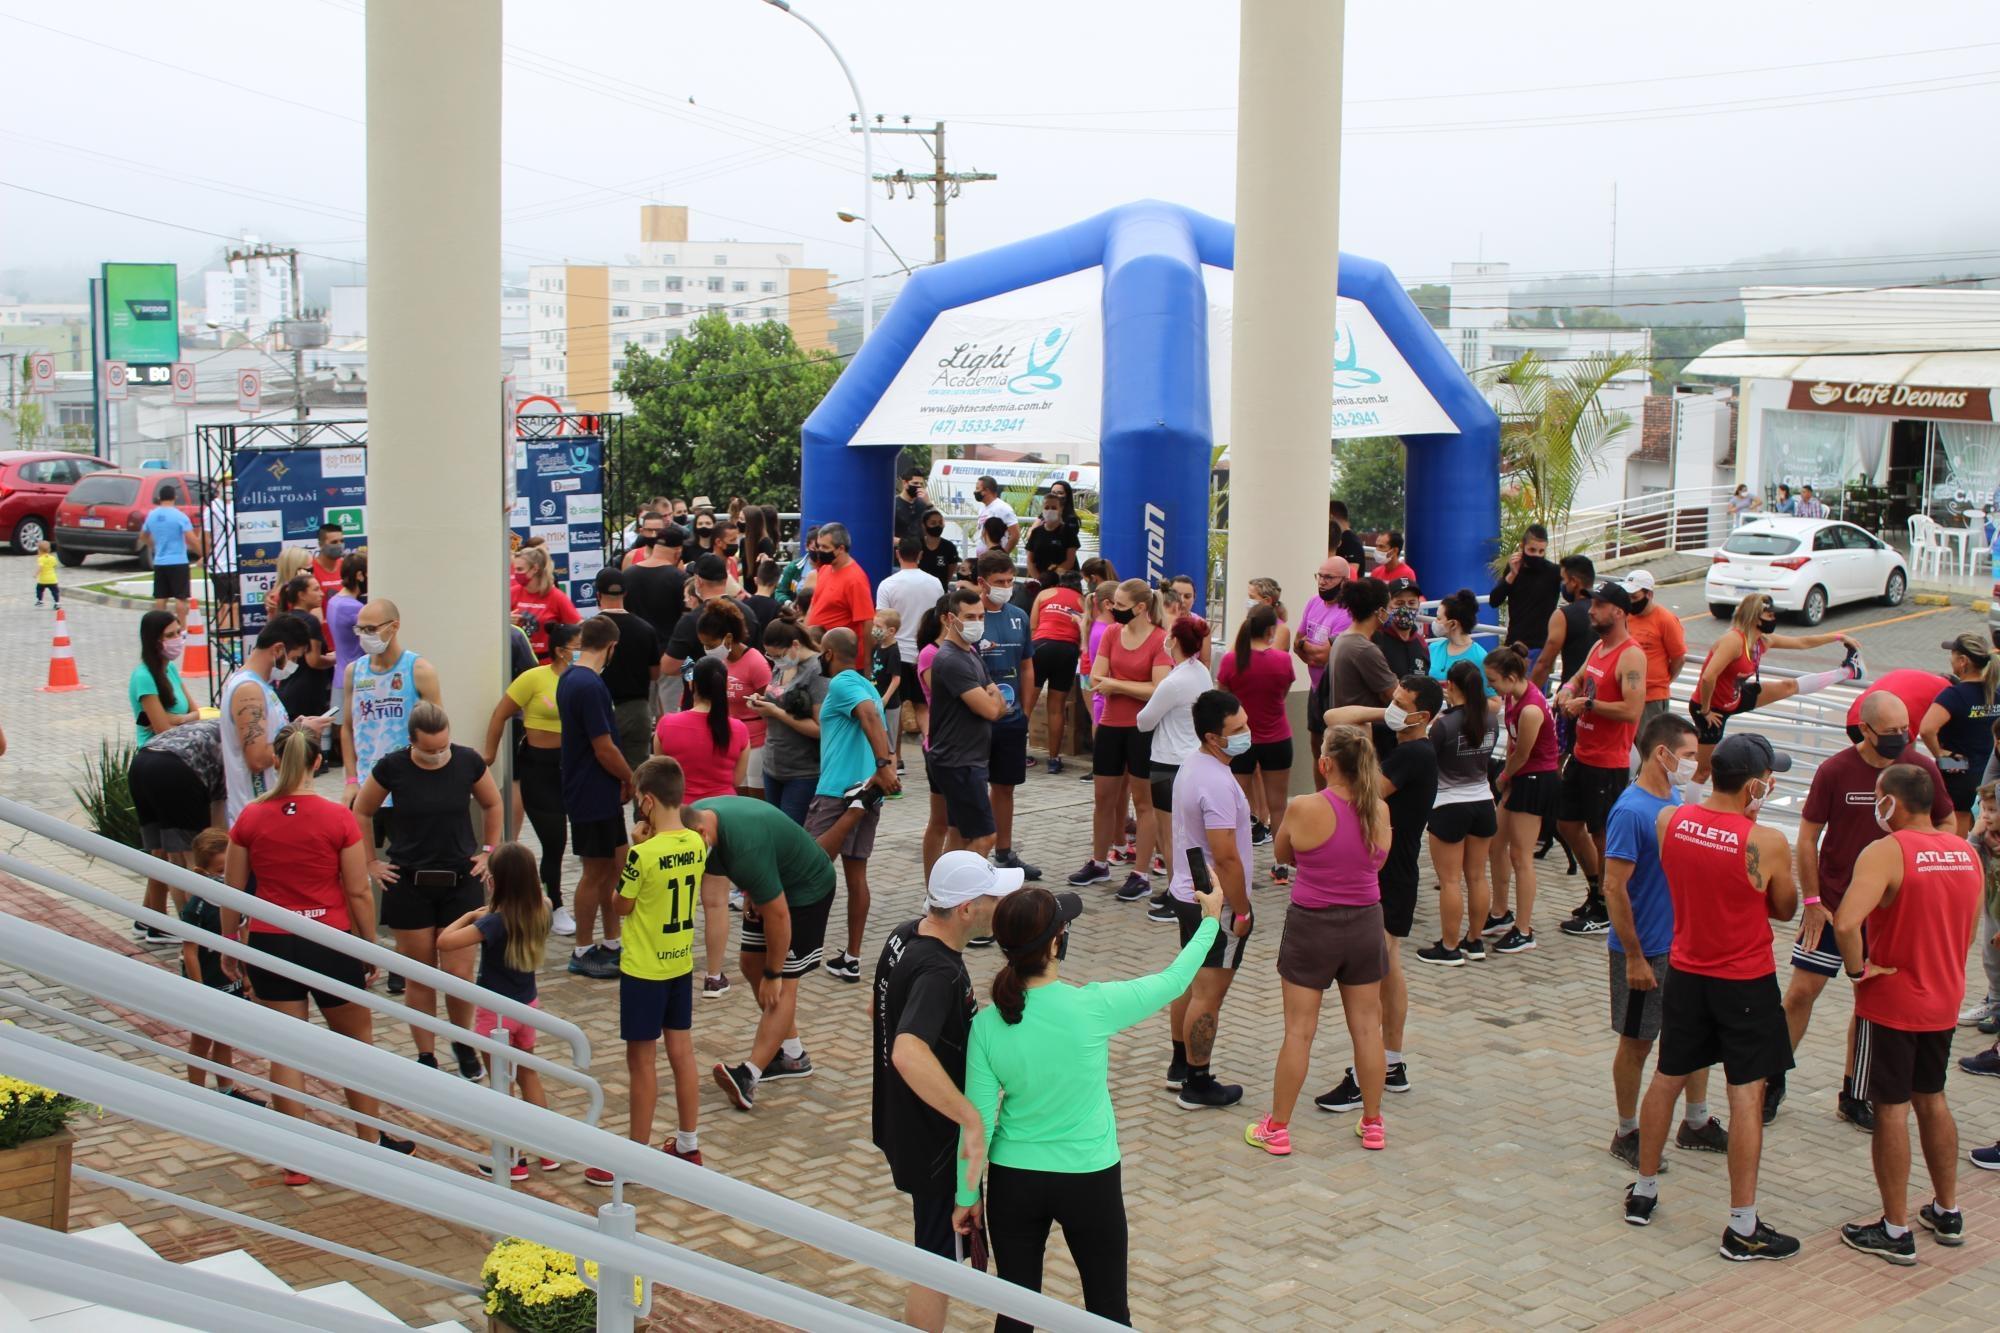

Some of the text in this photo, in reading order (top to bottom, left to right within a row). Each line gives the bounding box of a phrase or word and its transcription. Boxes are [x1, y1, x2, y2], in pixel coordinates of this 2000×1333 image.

[938, 342, 1016, 376] Light
[931, 368, 1009, 387] Academia
[1843, 383, 1968, 408] Café Deonas
[919, 401, 1053, 415] www.lightacademia.com.br
[930, 418, 1025, 435] (47) 3533-2941
[340, 454, 361, 464] MIX
[952, 466, 985, 475] PREFEITURA
[986, 467, 1017, 477] MUNICIPAL
[242, 490, 317, 505] ellis rossi
[547, 532, 566, 541] MIX
[1010, 618, 1021, 630] 17
[1676, 819, 1739, 846] ATLETA
[659, 851, 695, 870] NEYMAR
[1915, 850, 1972, 864] ATLETA
[662, 874, 695, 934] 11
[656, 944, 690, 960] unicef
